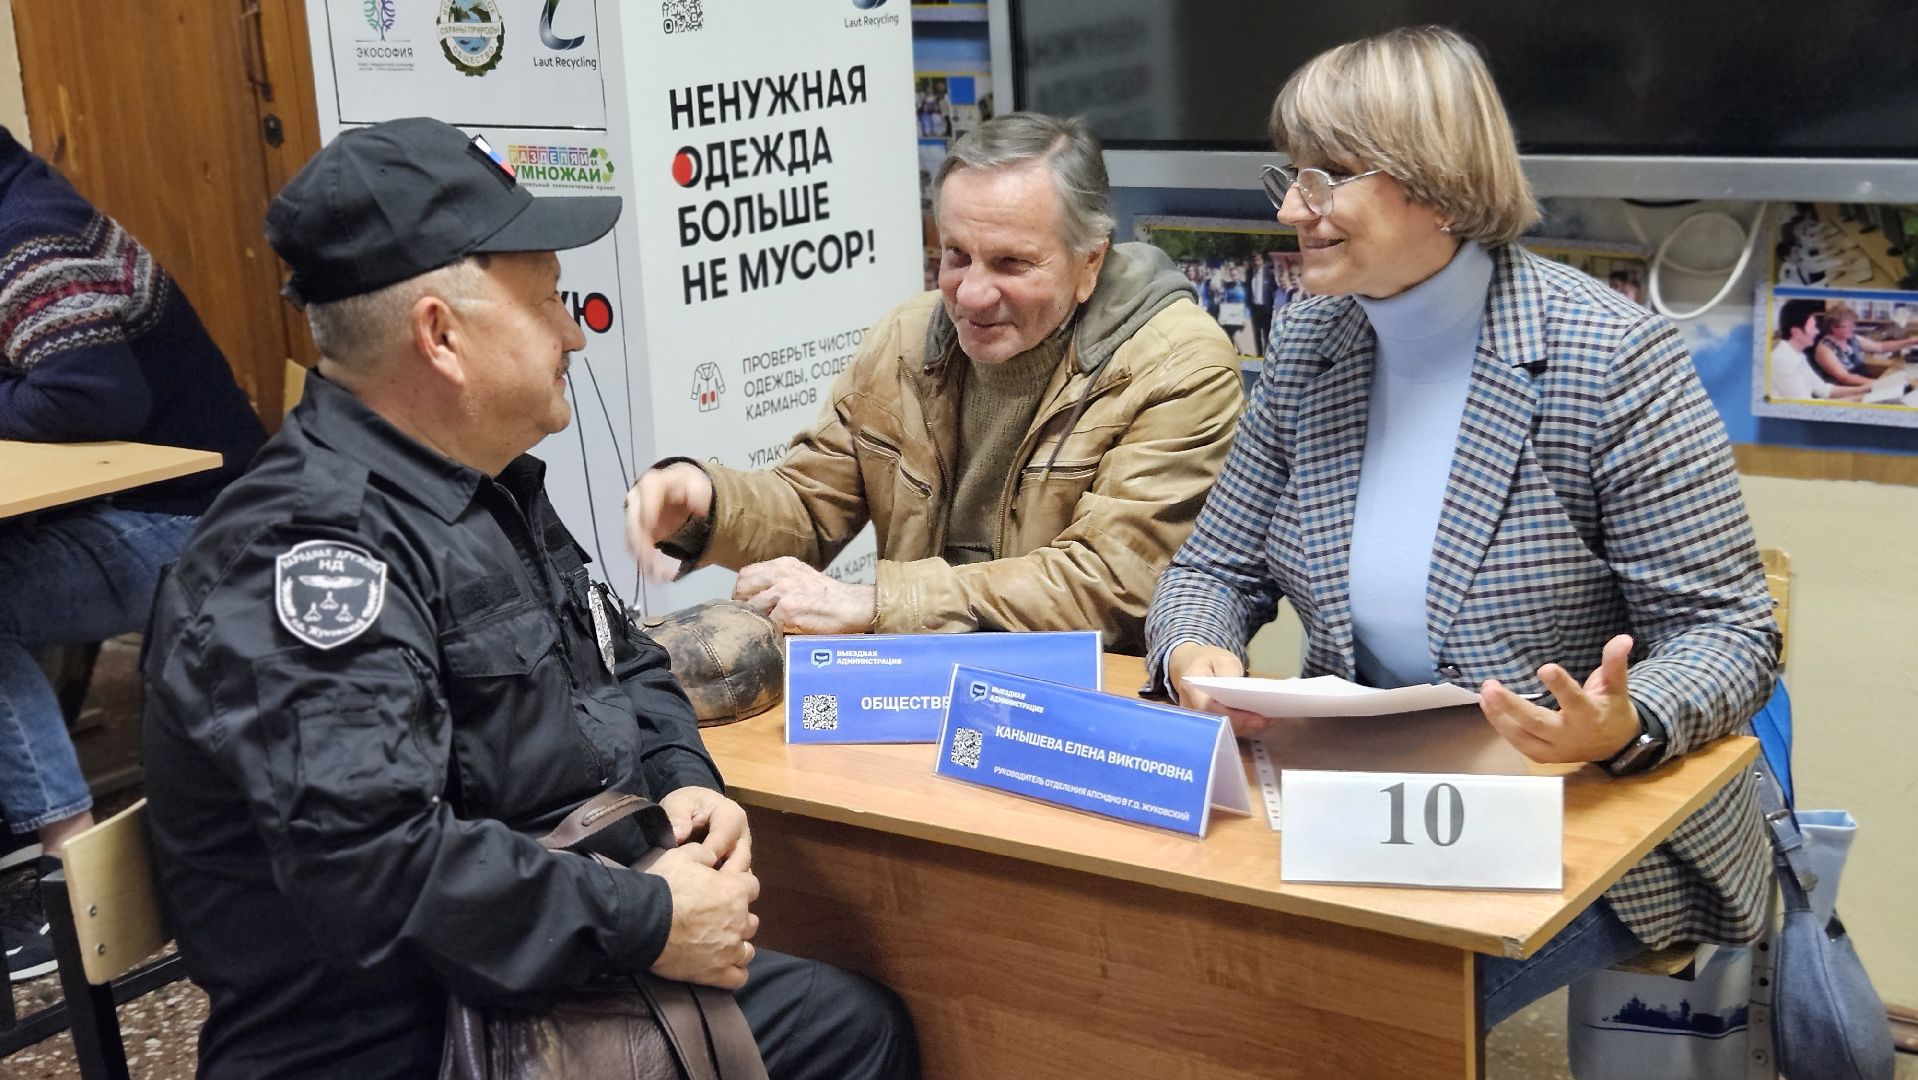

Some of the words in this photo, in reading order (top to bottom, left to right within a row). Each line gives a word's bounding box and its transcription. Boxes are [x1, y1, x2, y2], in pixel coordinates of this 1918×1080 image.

[844, 17, 862, 28] Laut
[863, 12, 899, 28] Recycling
[356, 47, 414, 59] ЭКОСОФИЯ
[453, 45, 494, 64] ОБЩЕСТВО
[533, 56, 554, 67] Laut
[555, 56, 597, 70] Recycling
[669, 64, 867, 130] НЕНУЖНАЯ
[672, 126, 833, 191] ОДЕЖДА
[678, 181, 830, 247] БОЛЬШЕ
[682, 257, 728, 305] НЕ
[739, 229, 875, 293] МУСОР!
[560, 290, 614, 334] Ю
[742, 340, 816, 375] ПРОВЕРЬТЕ
[744, 368, 808, 398] ОДЕЖДЫ,
[746, 387, 817, 421] КАРМАНОВ
[282, 549, 332, 569] НАРОДНАЯ
[318, 560, 345, 572] НД
[836, 650, 878, 658] ВЫЕЗДНАЯ
[836, 658, 902, 666] АДМИНИСТРАЦИЯ
[989, 695, 1045, 714] АДМИНИСТРАЦИЯ
[991, 686, 1026, 700] ВЫЕЗДНАЯ
[995, 725, 1063, 752] КАНЫШЕВА
[1064, 740, 1106, 763] ЕЛЕНА
[1107, 750, 1194, 783] ВИКТОРОВНА
[993, 765, 1045, 786] РУКОВОДИТЕЛЬ
[1045, 779, 1087, 796] ОТДЕЛЕНИЯ
[1121, 797, 1128, 806] В
[1141, 802, 1190, 822] ЖУКОВСКИЙ
[1379, 782, 1465, 846] 10
